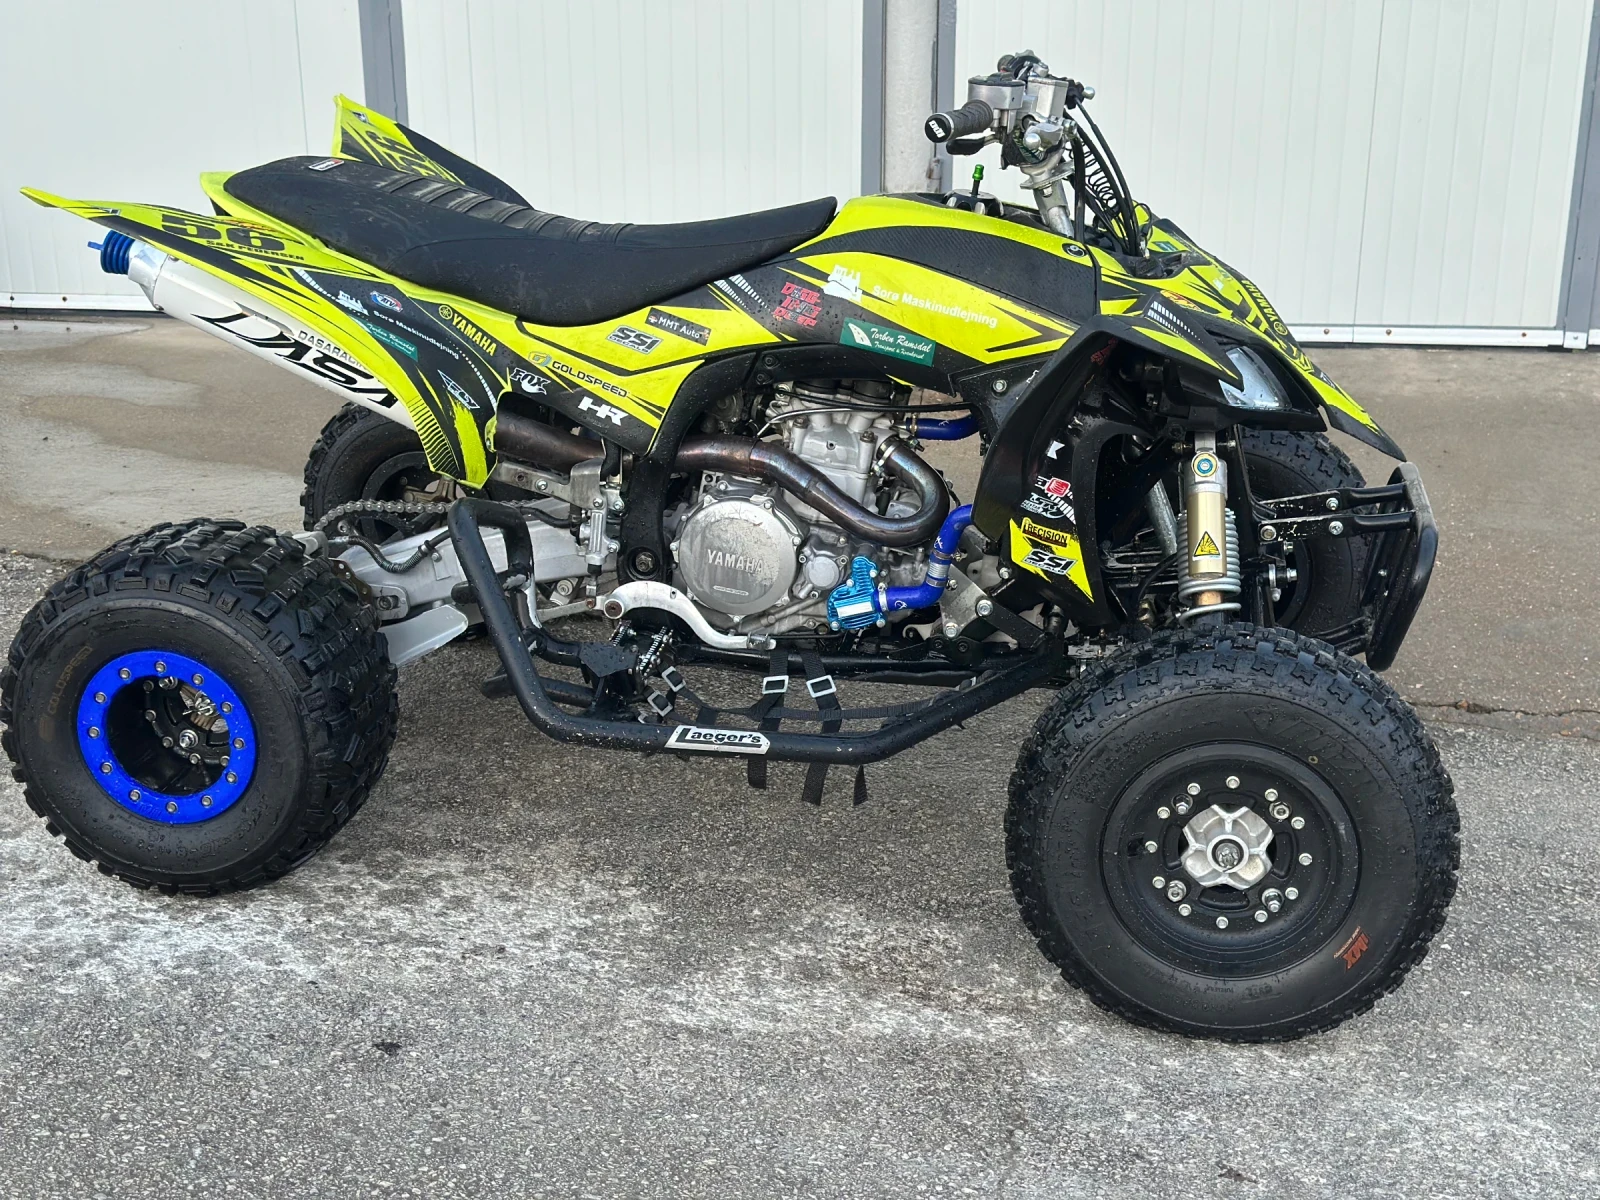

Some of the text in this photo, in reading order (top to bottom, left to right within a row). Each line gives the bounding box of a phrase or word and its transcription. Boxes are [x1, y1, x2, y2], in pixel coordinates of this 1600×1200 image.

[162, 214, 285, 251] 56
[901, 292, 998, 329] Maskinudlejning
[451, 313, 497, 357] YAMAHA
[612, 326, 660, 349] SSI
[658, 315, 701, 339] MMT Auto
[870, 328, 933, 354] Torben Ramsdal
[510, 368, 551, 388] FOX
[552, 361, 628, 398] GOLDSPEED
[707, 549, 764, 574] YAMAHA
[1027, 550, 1075, 572] SSI
